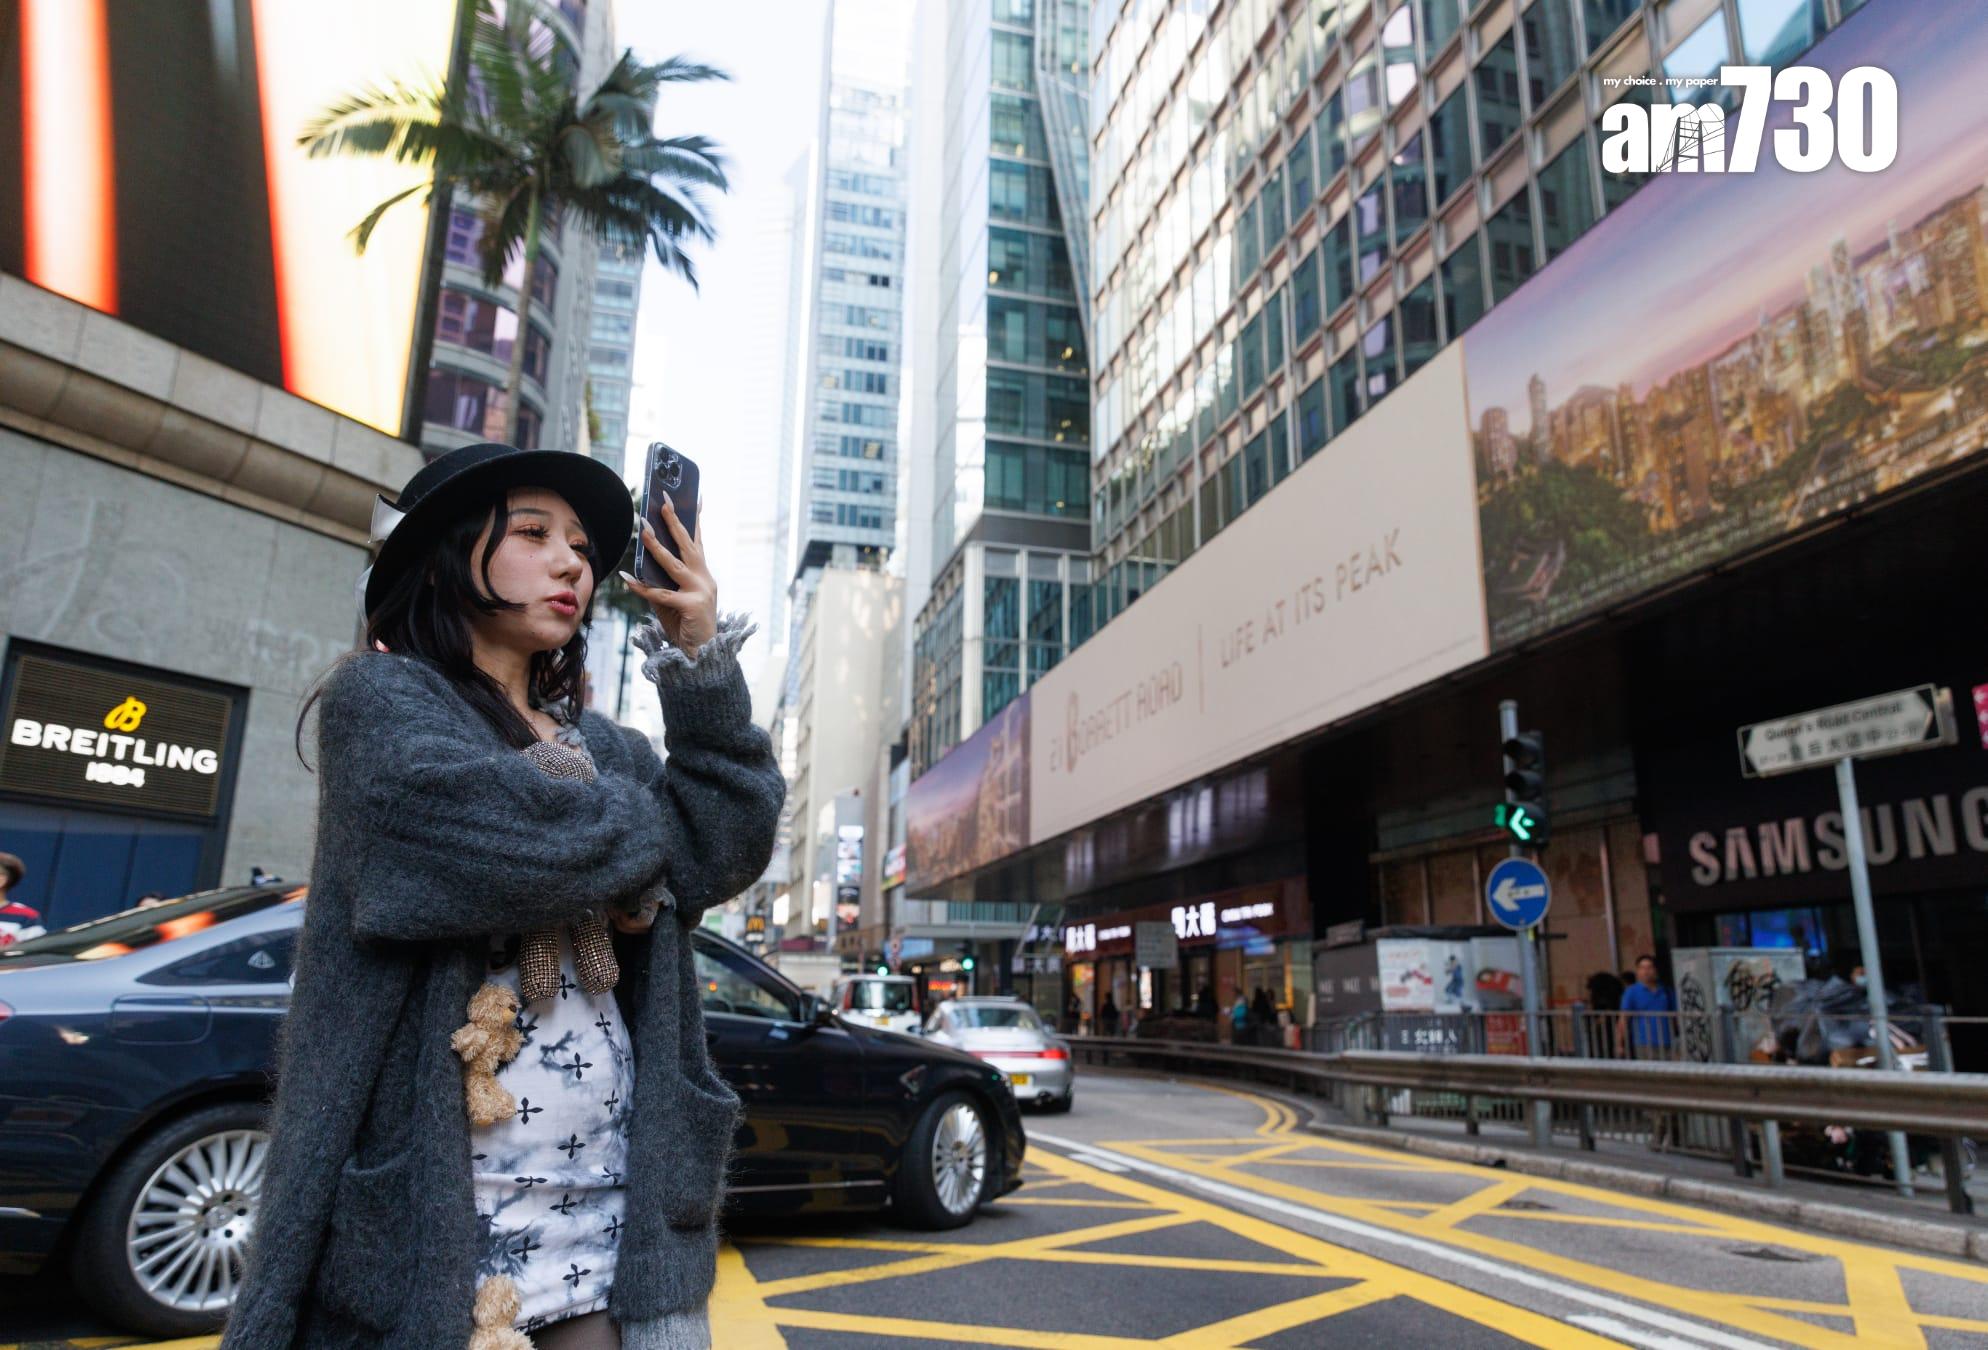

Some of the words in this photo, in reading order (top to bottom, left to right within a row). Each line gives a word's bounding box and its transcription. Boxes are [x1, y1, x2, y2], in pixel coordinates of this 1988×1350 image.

[1220, 619, 1255, 669] LIFE
[1262, 599, 1286, 645] AT
[1294, 575, 1326, 626] ITS
[1335, 527, 1402, 602] PEAK
[11, 718, 218, 775] BREITLING
